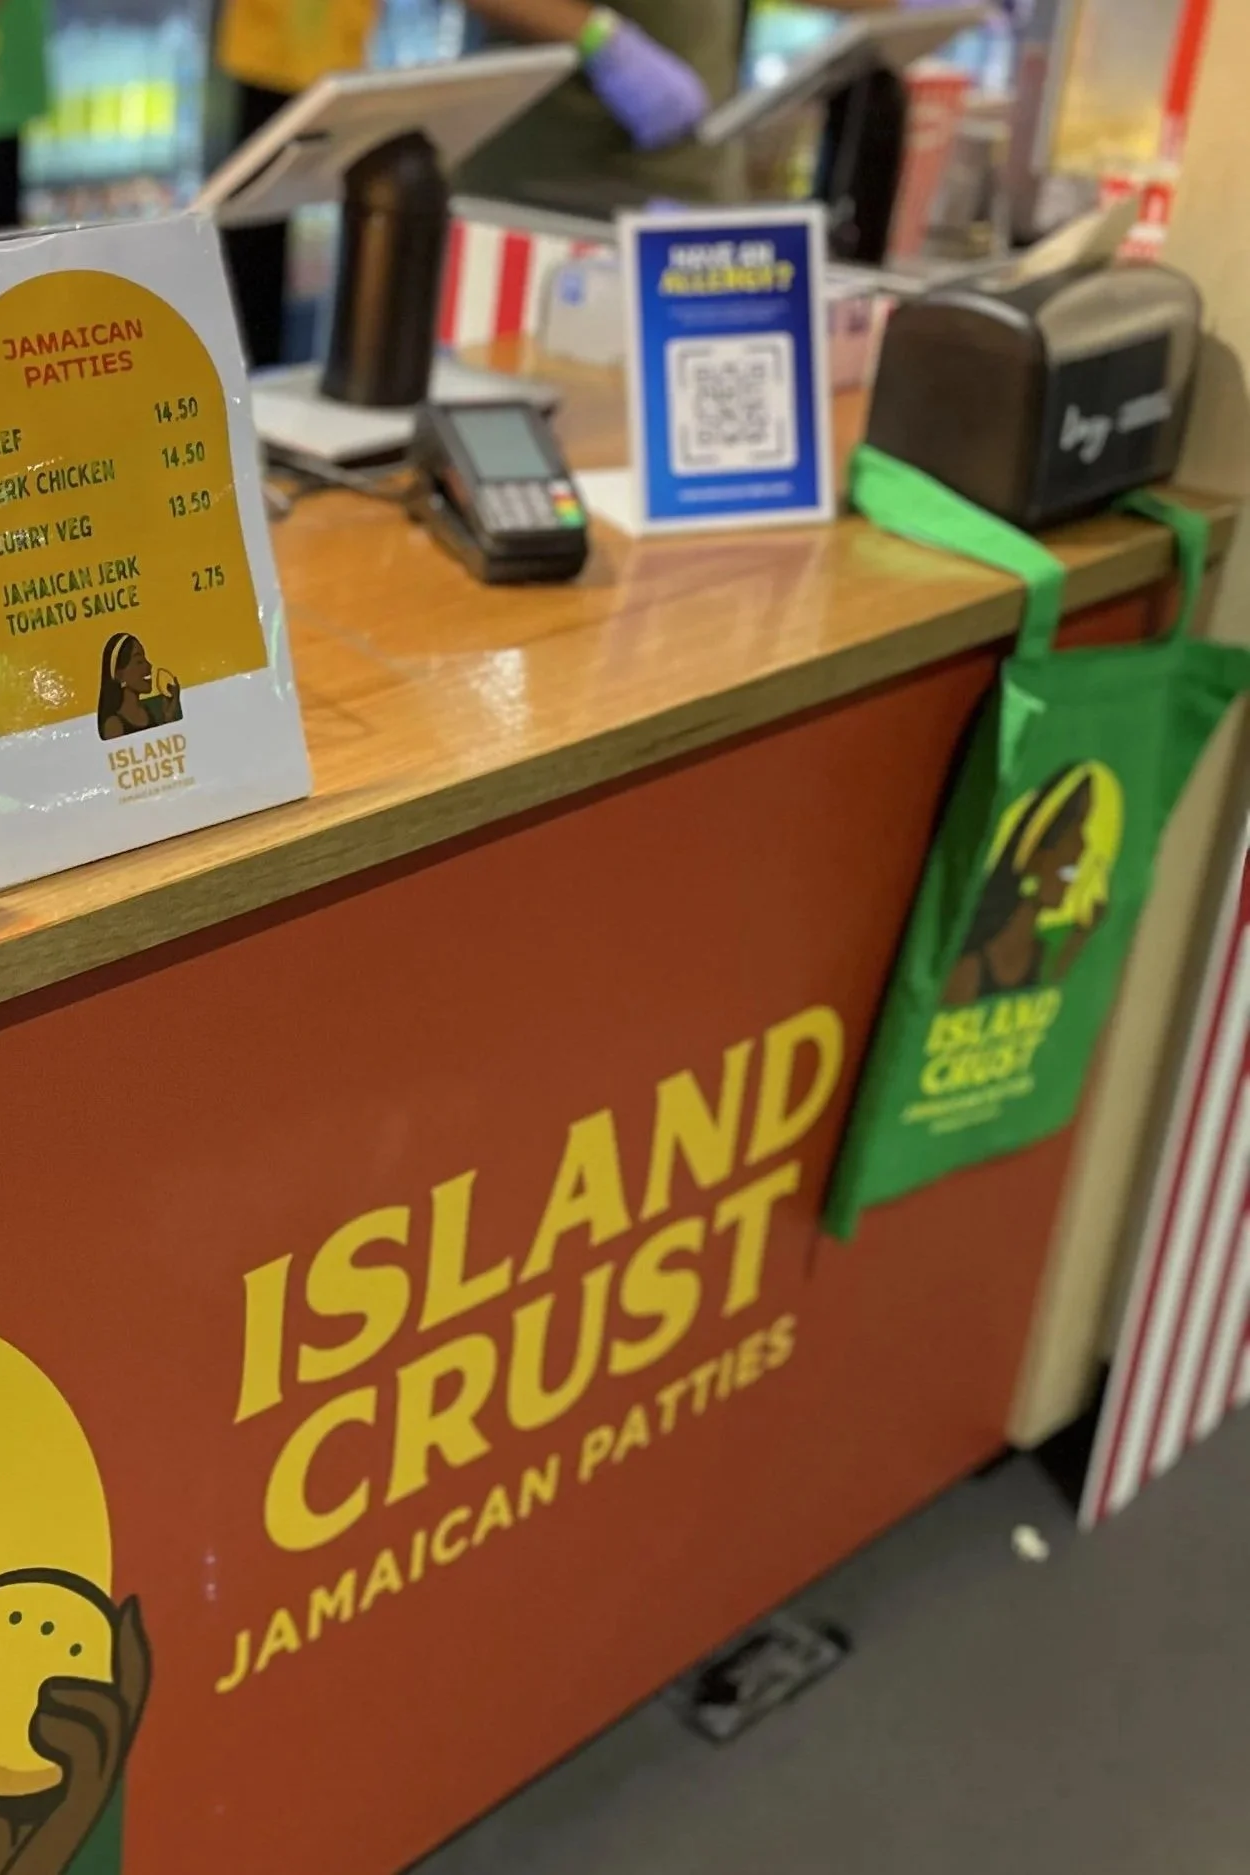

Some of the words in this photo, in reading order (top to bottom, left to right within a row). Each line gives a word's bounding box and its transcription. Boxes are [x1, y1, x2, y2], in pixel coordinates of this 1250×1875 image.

[2, 319, 143, 361] JAMAICAN
[25, 350, 134, 390] PATTIES
[154, 396, 198, 423] 14.50
[36, 459, 116, 495] CHICKEN
[162, 441, 206, 468] 14.50
[55, 515, 92, 542] VEG
[168, 490, 211, 518] 13.50
[3, 566, 93, 608] JAMAICAN
[98, 555, 141, 586] JERK
[191, 565, 226, 592] 2.75
[6, 600, 77, 636] TOMATO
[83, 585, 140, 618] SAUCE
[108, 734, 186, 771] ISLAND
[118, 755, 185, 790] CRUST
[925, 987, 1062, 1054] ISLAND
[920, 1029, 1047, 1095] CRUST
[234, 1005, 845, 1424] ISLAND
[263, 1160, 801, 1551] CRUST
[216, 1454, 560, 1694] JAMAICAN
[578, 1314, 797, 1483] PATTIES
